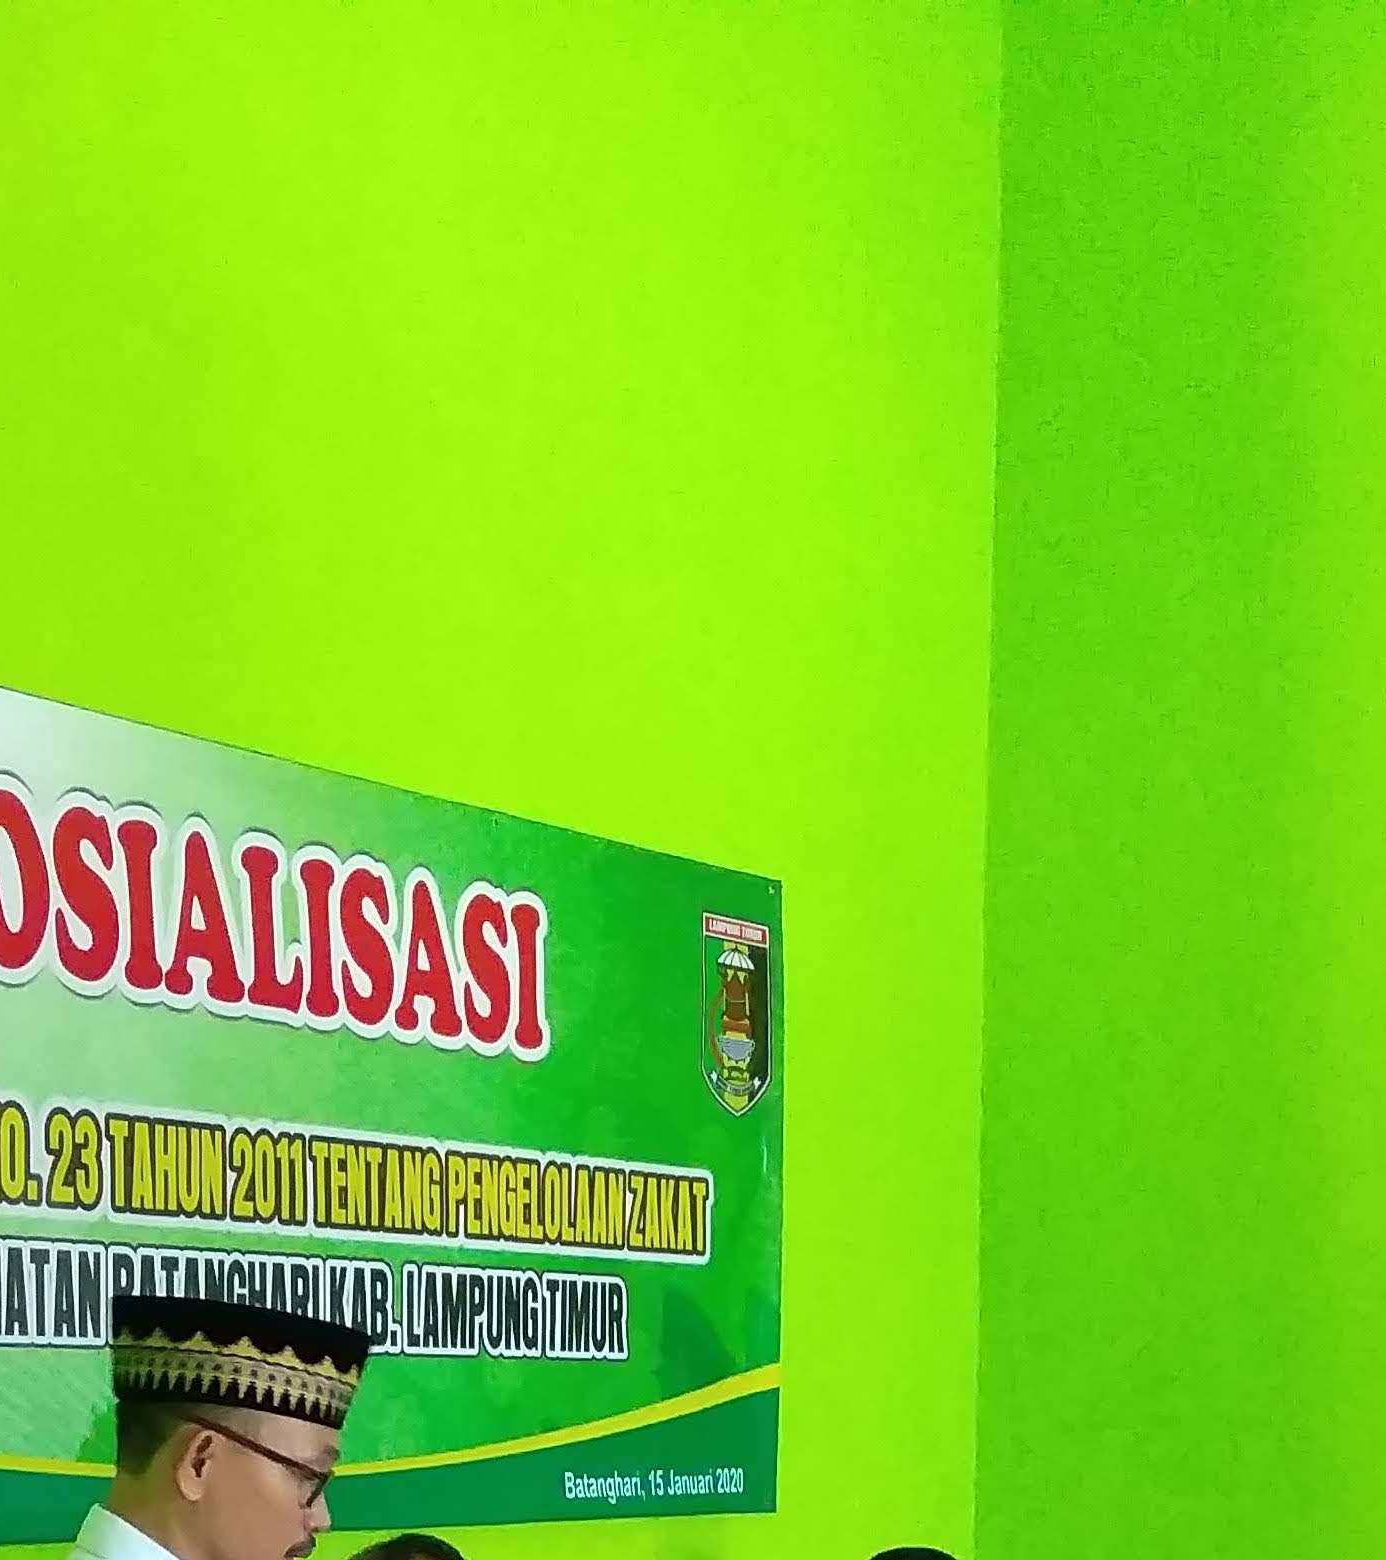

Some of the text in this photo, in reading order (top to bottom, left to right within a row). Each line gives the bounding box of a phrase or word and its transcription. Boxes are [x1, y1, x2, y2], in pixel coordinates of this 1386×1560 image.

[46, 1110, 102, 1207] 23
[108, 1116, 224, 1218] TAHUN
[230, 1130, 310, 1224] 2011
[312, 1138, 443, 1233] TENTANG
[446, 1152, 626, 1247] PENGELOLAAN
[627, 1172, 708, 1253] ZAKAT
[328, 1264, 400, 1346] KAB.
[406, 1276, 540, 1350] LAMPUNG
[544, 1286, 625, 1353] TIMUR
[564, 1467, 744, 1504] Batanghari, 15 Januari 2020
